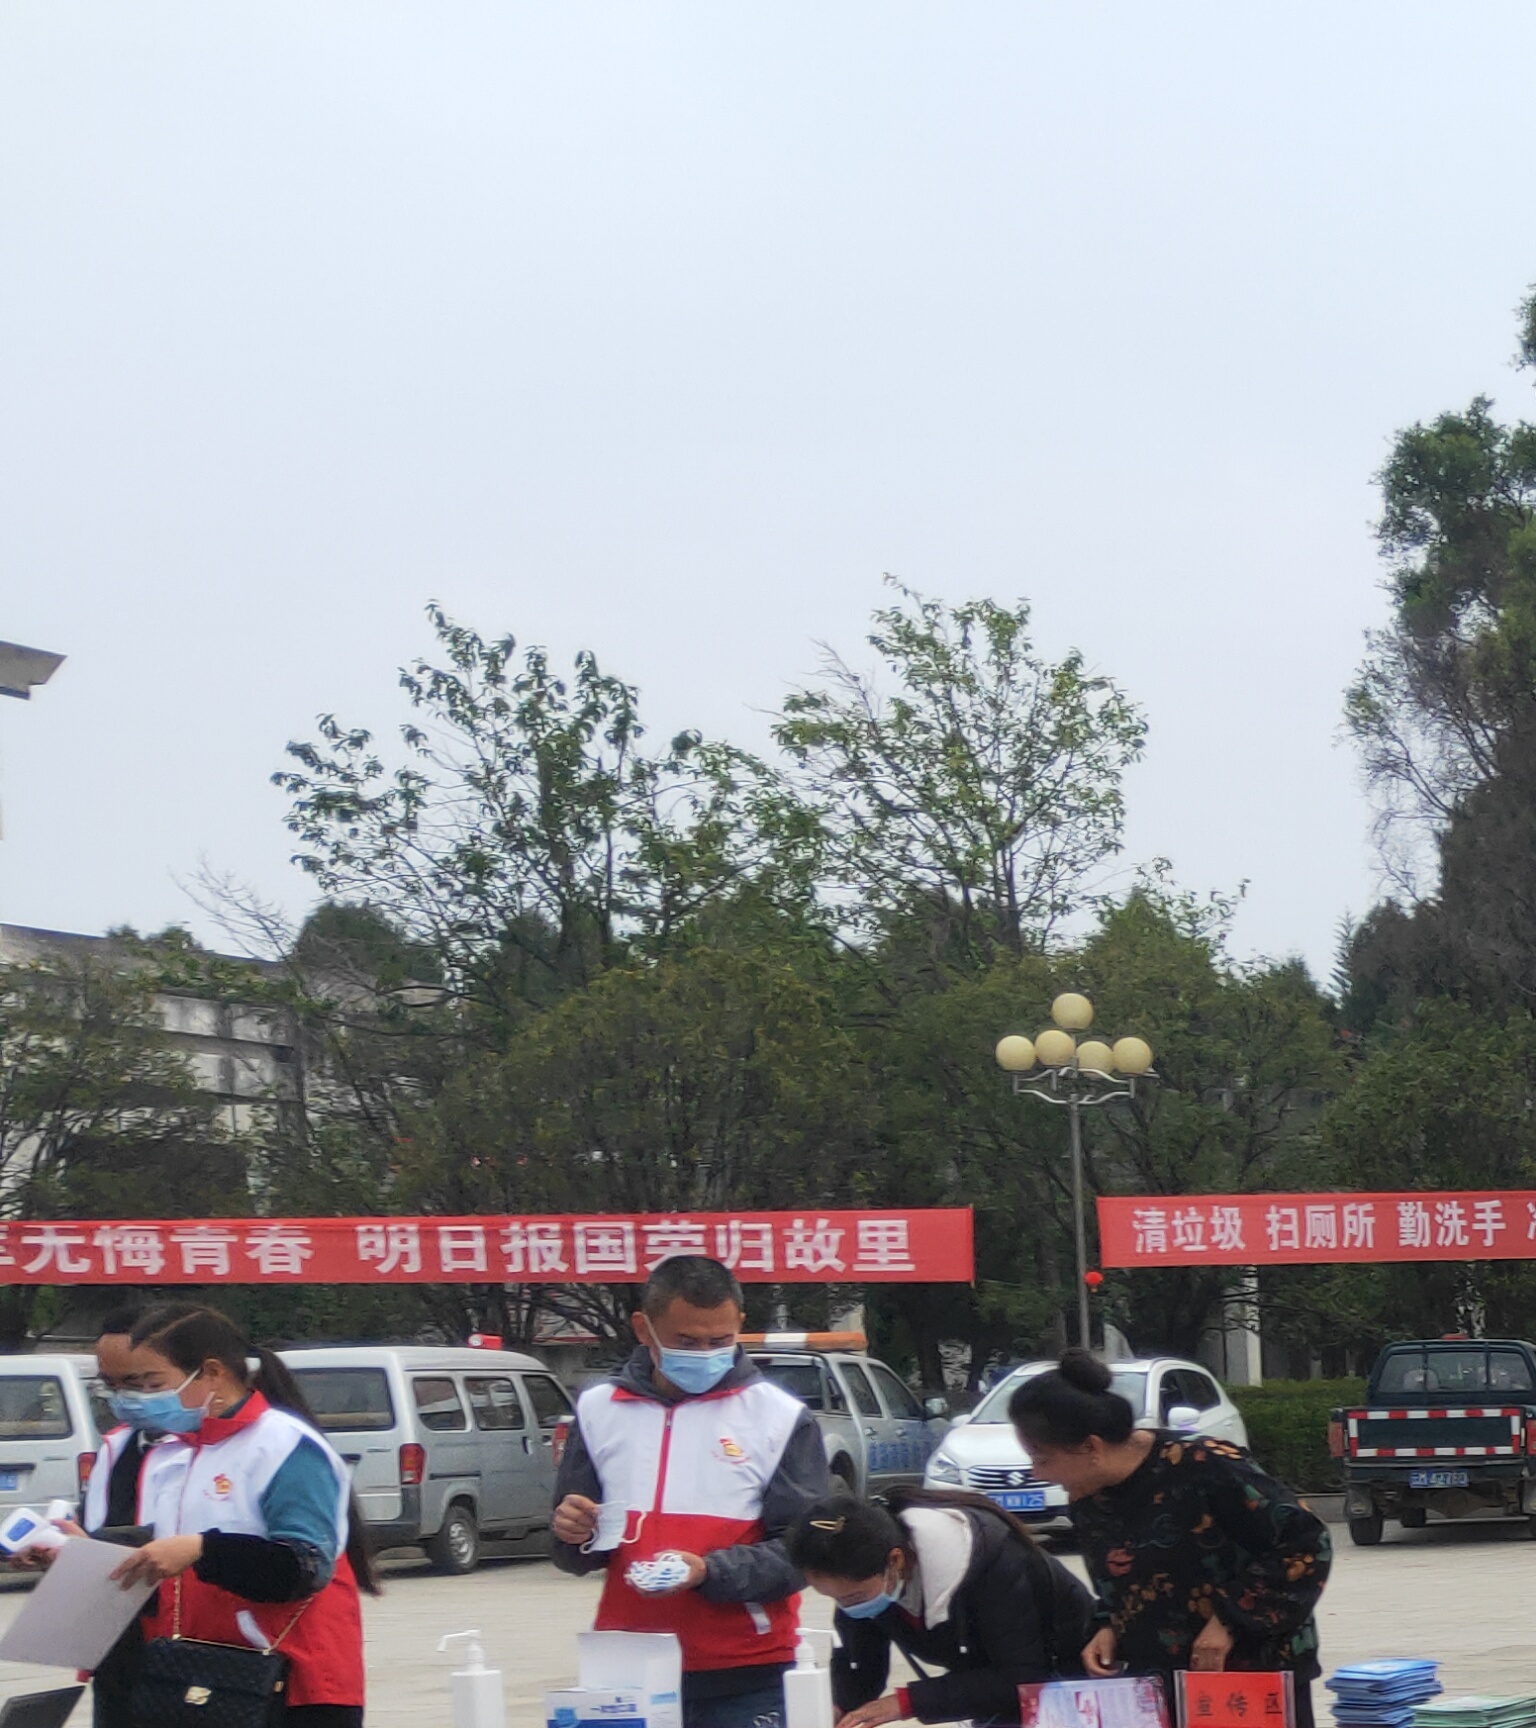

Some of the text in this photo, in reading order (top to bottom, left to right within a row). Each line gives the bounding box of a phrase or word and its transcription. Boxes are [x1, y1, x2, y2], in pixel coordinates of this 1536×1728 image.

[356, 1217, 916, 1275] 明日报国荣归故里
[1133, 1207, 1247, 1254] 清垃圾
[1265, 1203, 1375, 1251] 扫厕所
[1397, 1201, 1507, 1248] 勤洗手
